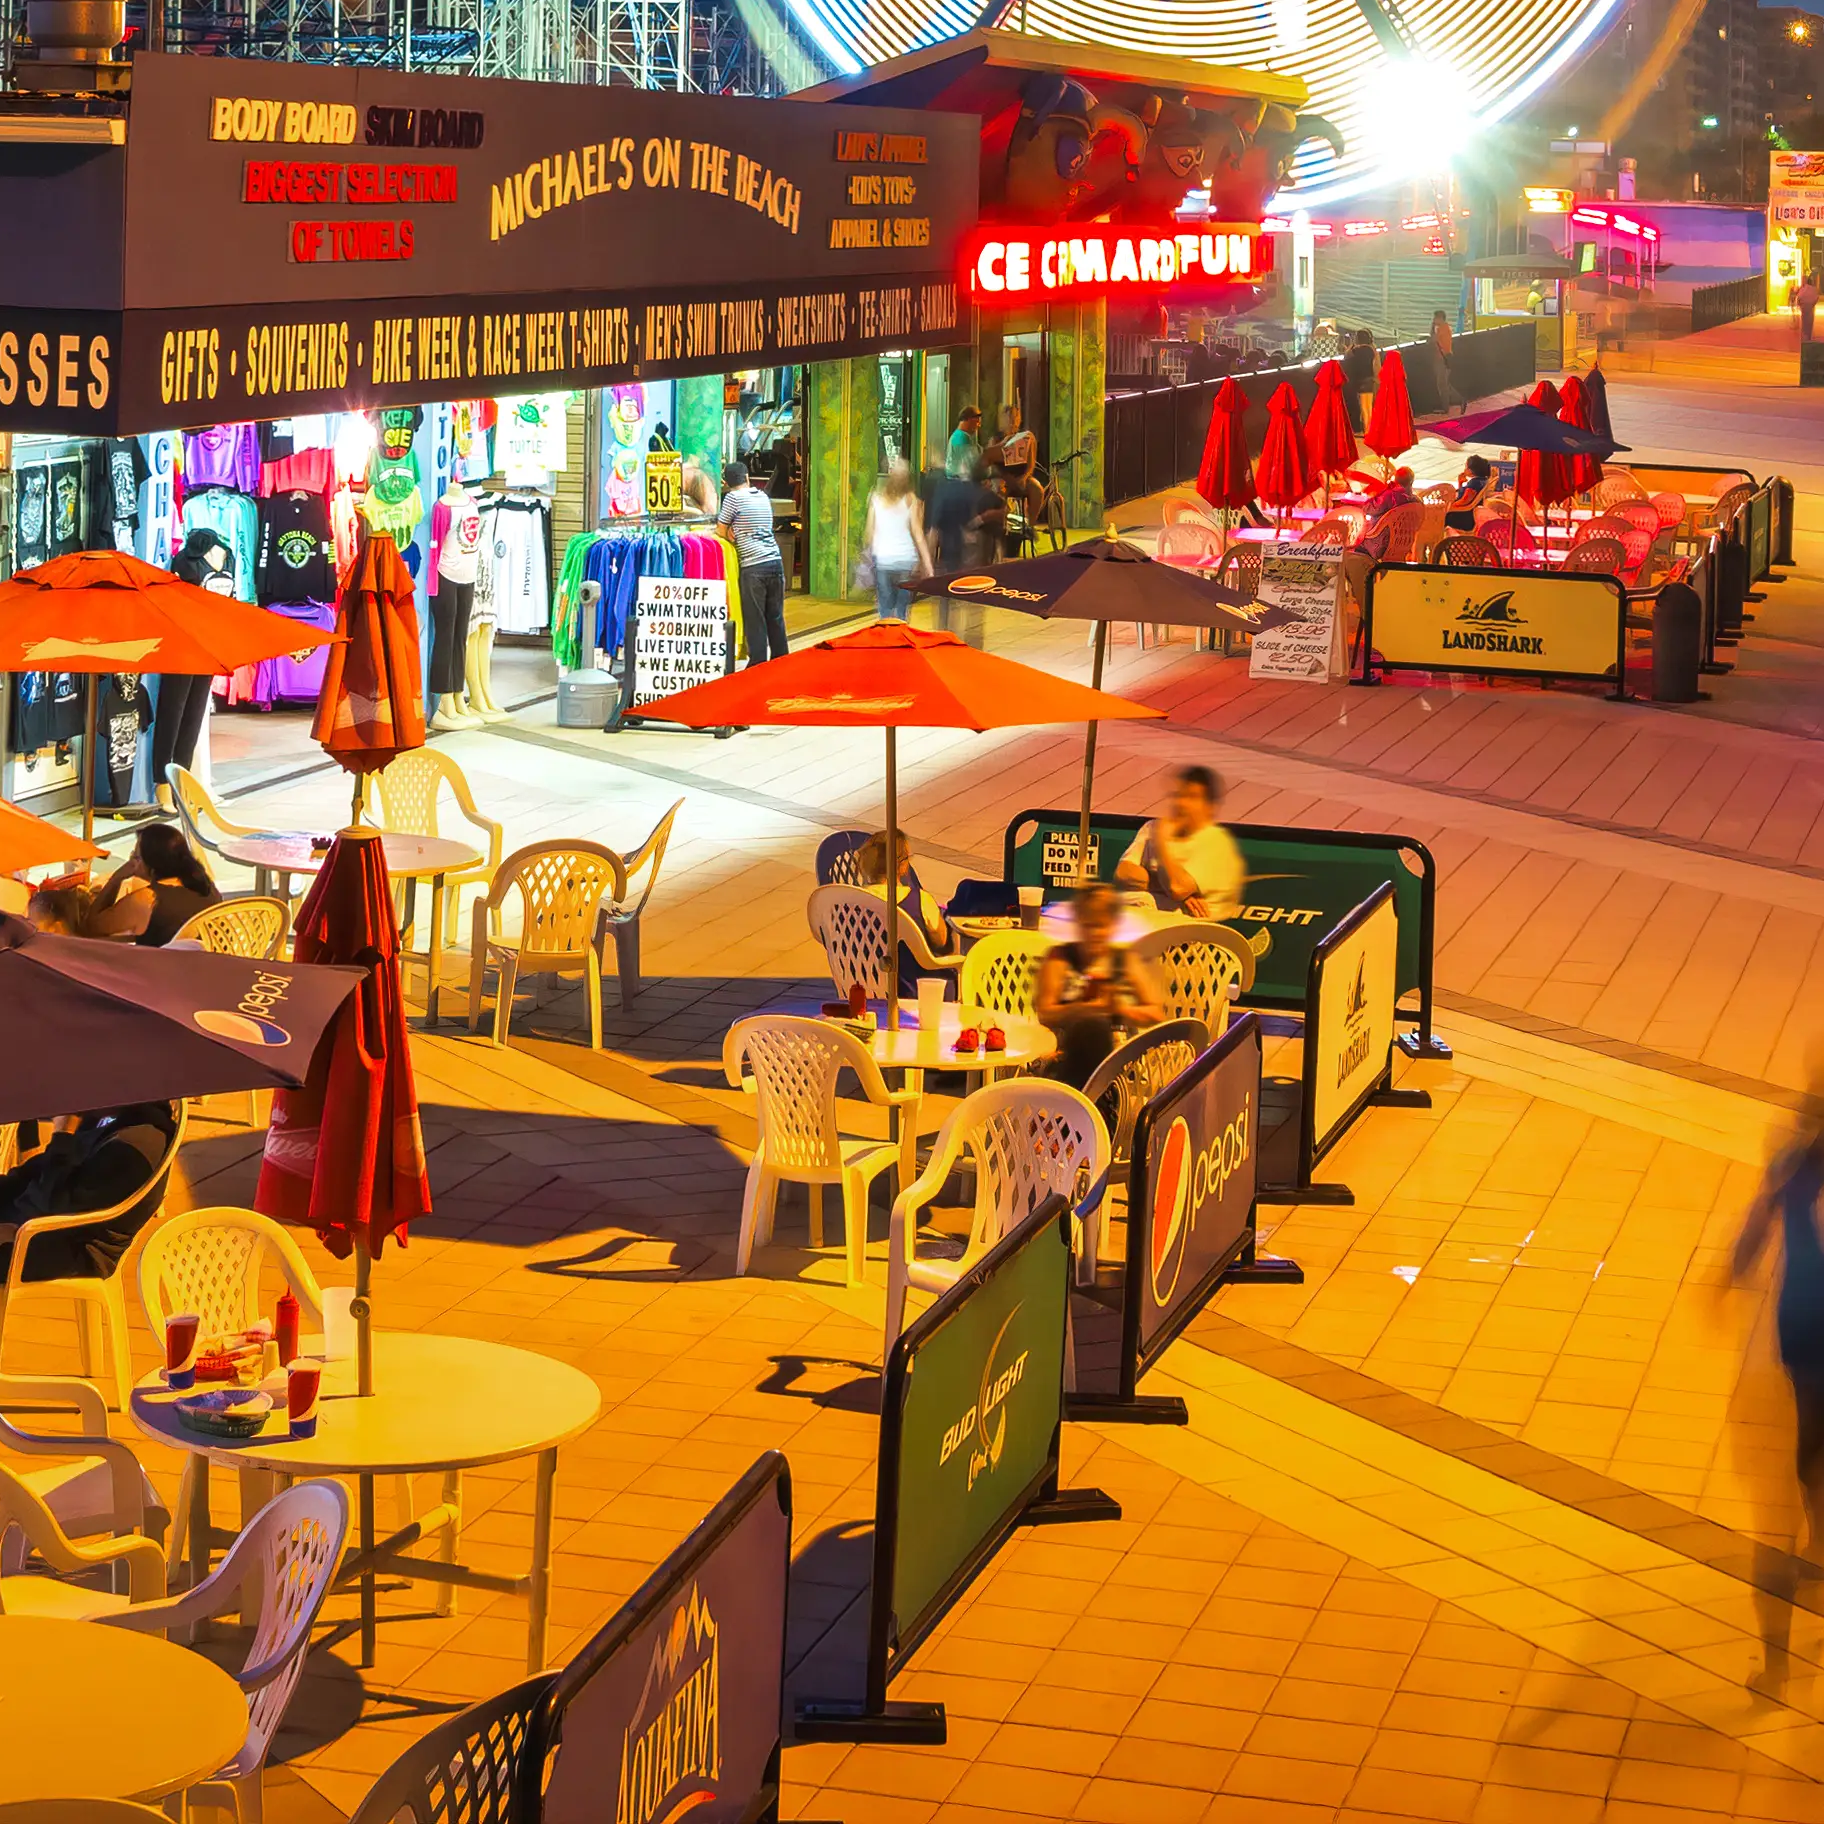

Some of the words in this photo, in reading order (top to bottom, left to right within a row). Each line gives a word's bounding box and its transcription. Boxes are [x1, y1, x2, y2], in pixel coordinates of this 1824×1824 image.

[213, 98, 283, 141] BODY
[284, 102, 358, 143] BOARD
[419, 109, 484, 148] BOARD
[245, 161, 344, 203] BIGGEST
[345, 163, 457, 203] SELECTION
[490, 137, 635, 240] MICHAEL'S
[643, 137, 681, 188] ON
[690, 142, 730, 196] THE
[734, 154, 801, 234] BEACH
[292, 221, 323, 262] OF
[328, 220, 414, 261] TOWELS
[161, 328, 218, 404] GIFTS
[246, 321, 348, 396] SOUVENIRS
[372, 319, 412, 384] BIKE
[418, 316, 461, 381] WEEK
[468, 315, 477, 377] &
[483, 313, 520, 376] RACE
[526, 312, 564, 372] WEEK
[569, 308, 628, 368] T-SHIRTS
[645, 304, 682, 360] MEN'S
[687, 303, 716, 358] SWIM
[720, 299, 764, 354] TRUNKS
[777, 292, 846, 348] SWEATSHIRTS
[859, 287, 911, 339] TEE-SHIRTS
[920, 283, 957, 332] SANDALS
[1277, 541, 1343, 560] Breakfast
[984, 585, 1048, 602] pepsi
[1255, 640, 1279, 650] SLICE
[1293, 644, 1328, 654] CHEESE
[1442, 629, 1544, 655] LANDSHARK
[649, 657, 669, 671] WE
[674, 658, 711, 674] MAKE
[1045, 862, 1071, 874] FEED
[1048, 848, 1065, 859] DO
[238, 969, 293, 1019] pepsi
[1190, 1091, 1250, 1232] pepsi
[939, 1405, 977, 1467] BUD
[982, 1350, 1028, 1418] LIGHT
